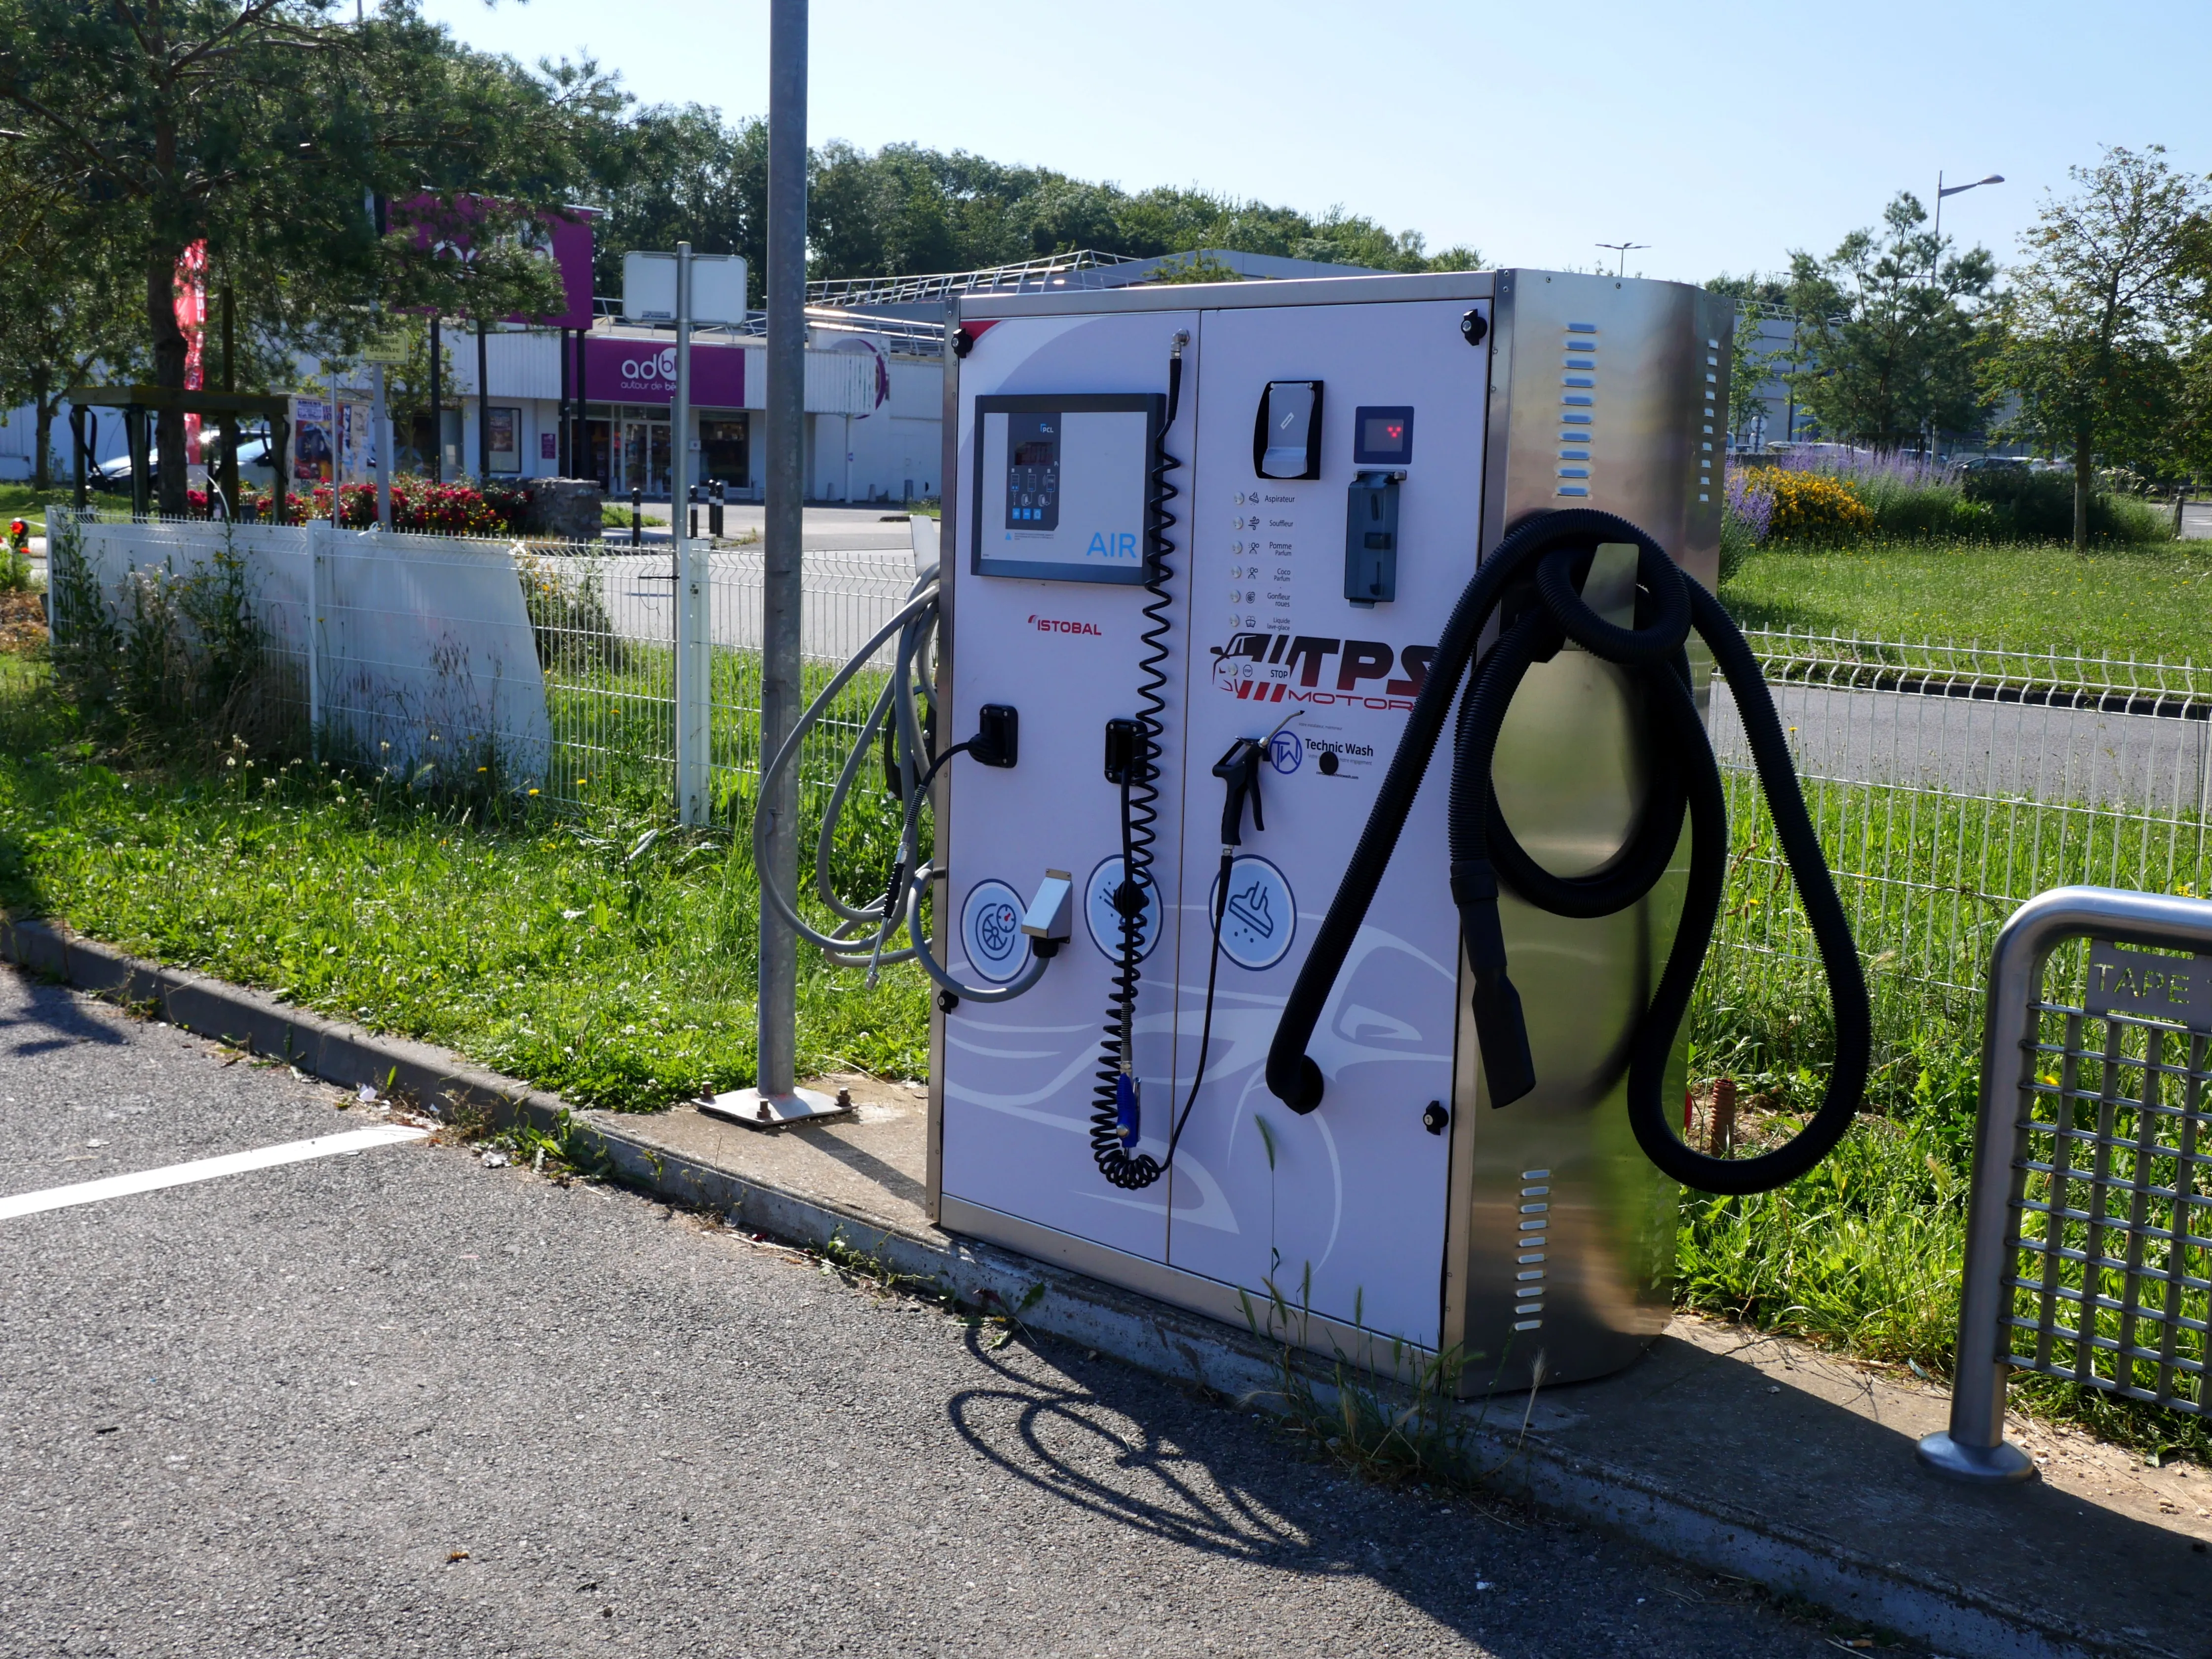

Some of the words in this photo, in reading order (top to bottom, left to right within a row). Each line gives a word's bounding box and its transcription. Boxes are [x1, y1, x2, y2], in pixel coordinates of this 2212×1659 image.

[621, 380, 649, 389] autour
[651, 381, 662, 390] de
[665, 382, 676, 391] bé
[1264, 495, 1295, 503] Aspirateur
[1086, 532, 1137, 558] AIR
[1037, 619, 1102, 636] ISTOBAL
[1270, 669, 1288, 678] STOP
[1285, 636, 1440, 697] TPS
[1305, 738, 1343, 753] Technic
[1345, 743, 1373, 757] Wash
[2094, 963, 2190, 1004] TAPE
